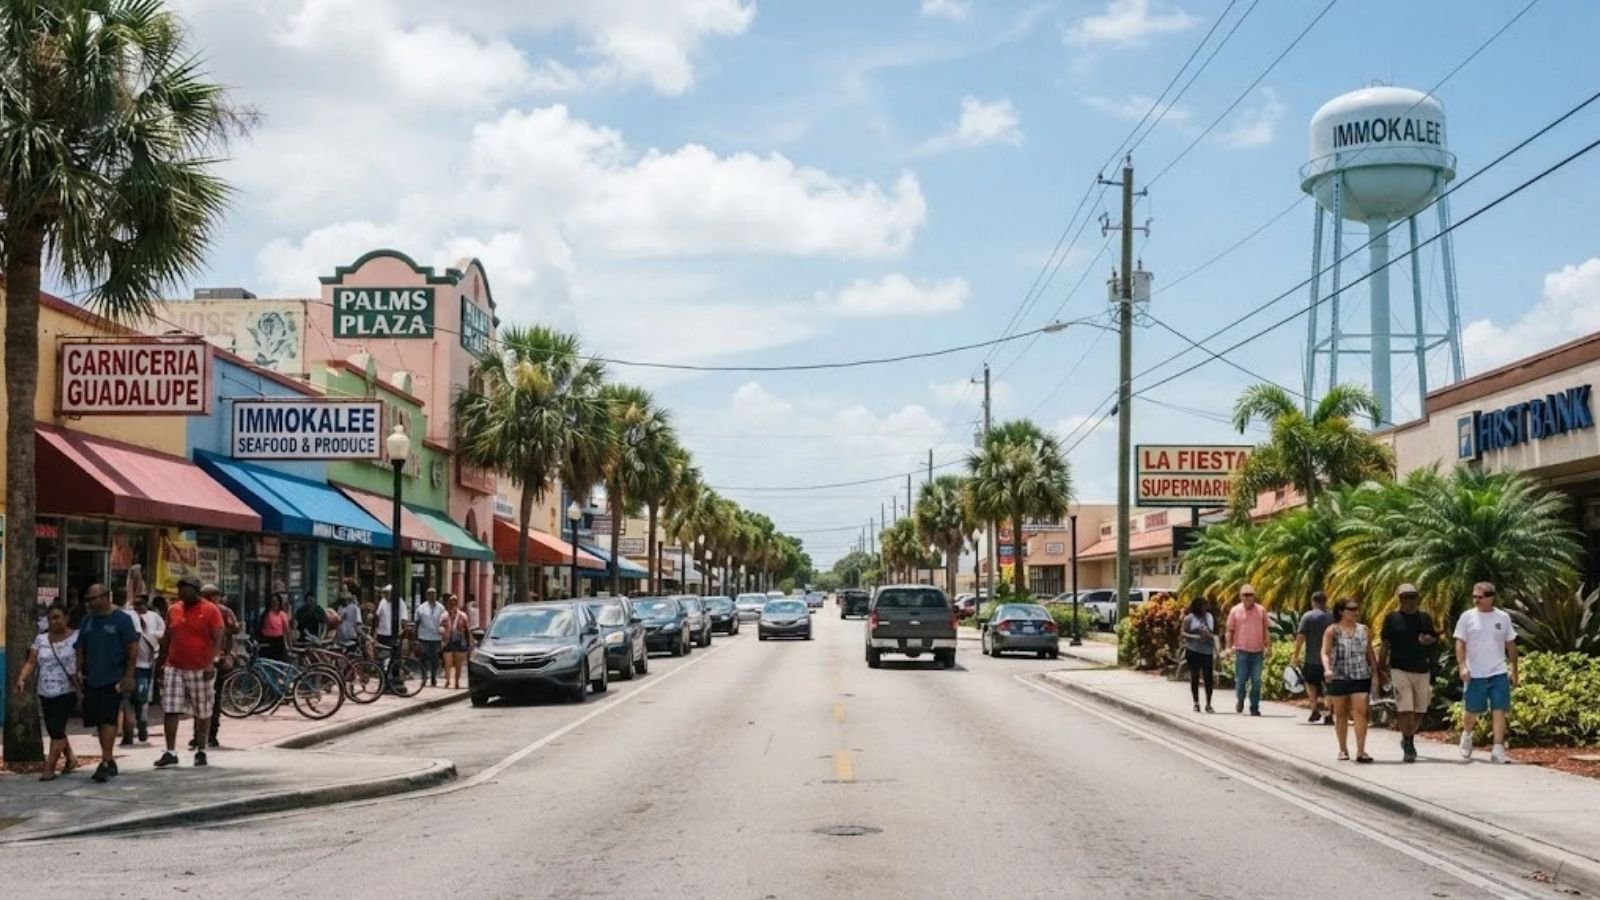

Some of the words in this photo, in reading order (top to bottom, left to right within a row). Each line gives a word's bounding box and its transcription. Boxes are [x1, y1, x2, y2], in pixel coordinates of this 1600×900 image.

[1333, 117, 1441, 149] IMMOKALEE
[340, 290, 428, 311] PALMS
[340, 314, 428, 335] PLAZA
[68, 350, 199, 376] CARNICERIA
[67, 378, 199, 406] GUADALUPE
[239, 407, 375, 433] IMMOKALEE
[1480, 403, 1529, 453] FIRST
[1529, 384, 1595, 439] BANK
[238, 437, 298, 453] SEAFOOD
[302, 437, 310, 453] &
[315, 437, 375, 453] PRODUCE
[1145, 450, 1171, 470] LA
[1178, 450, 1248, 470] FIESTA
